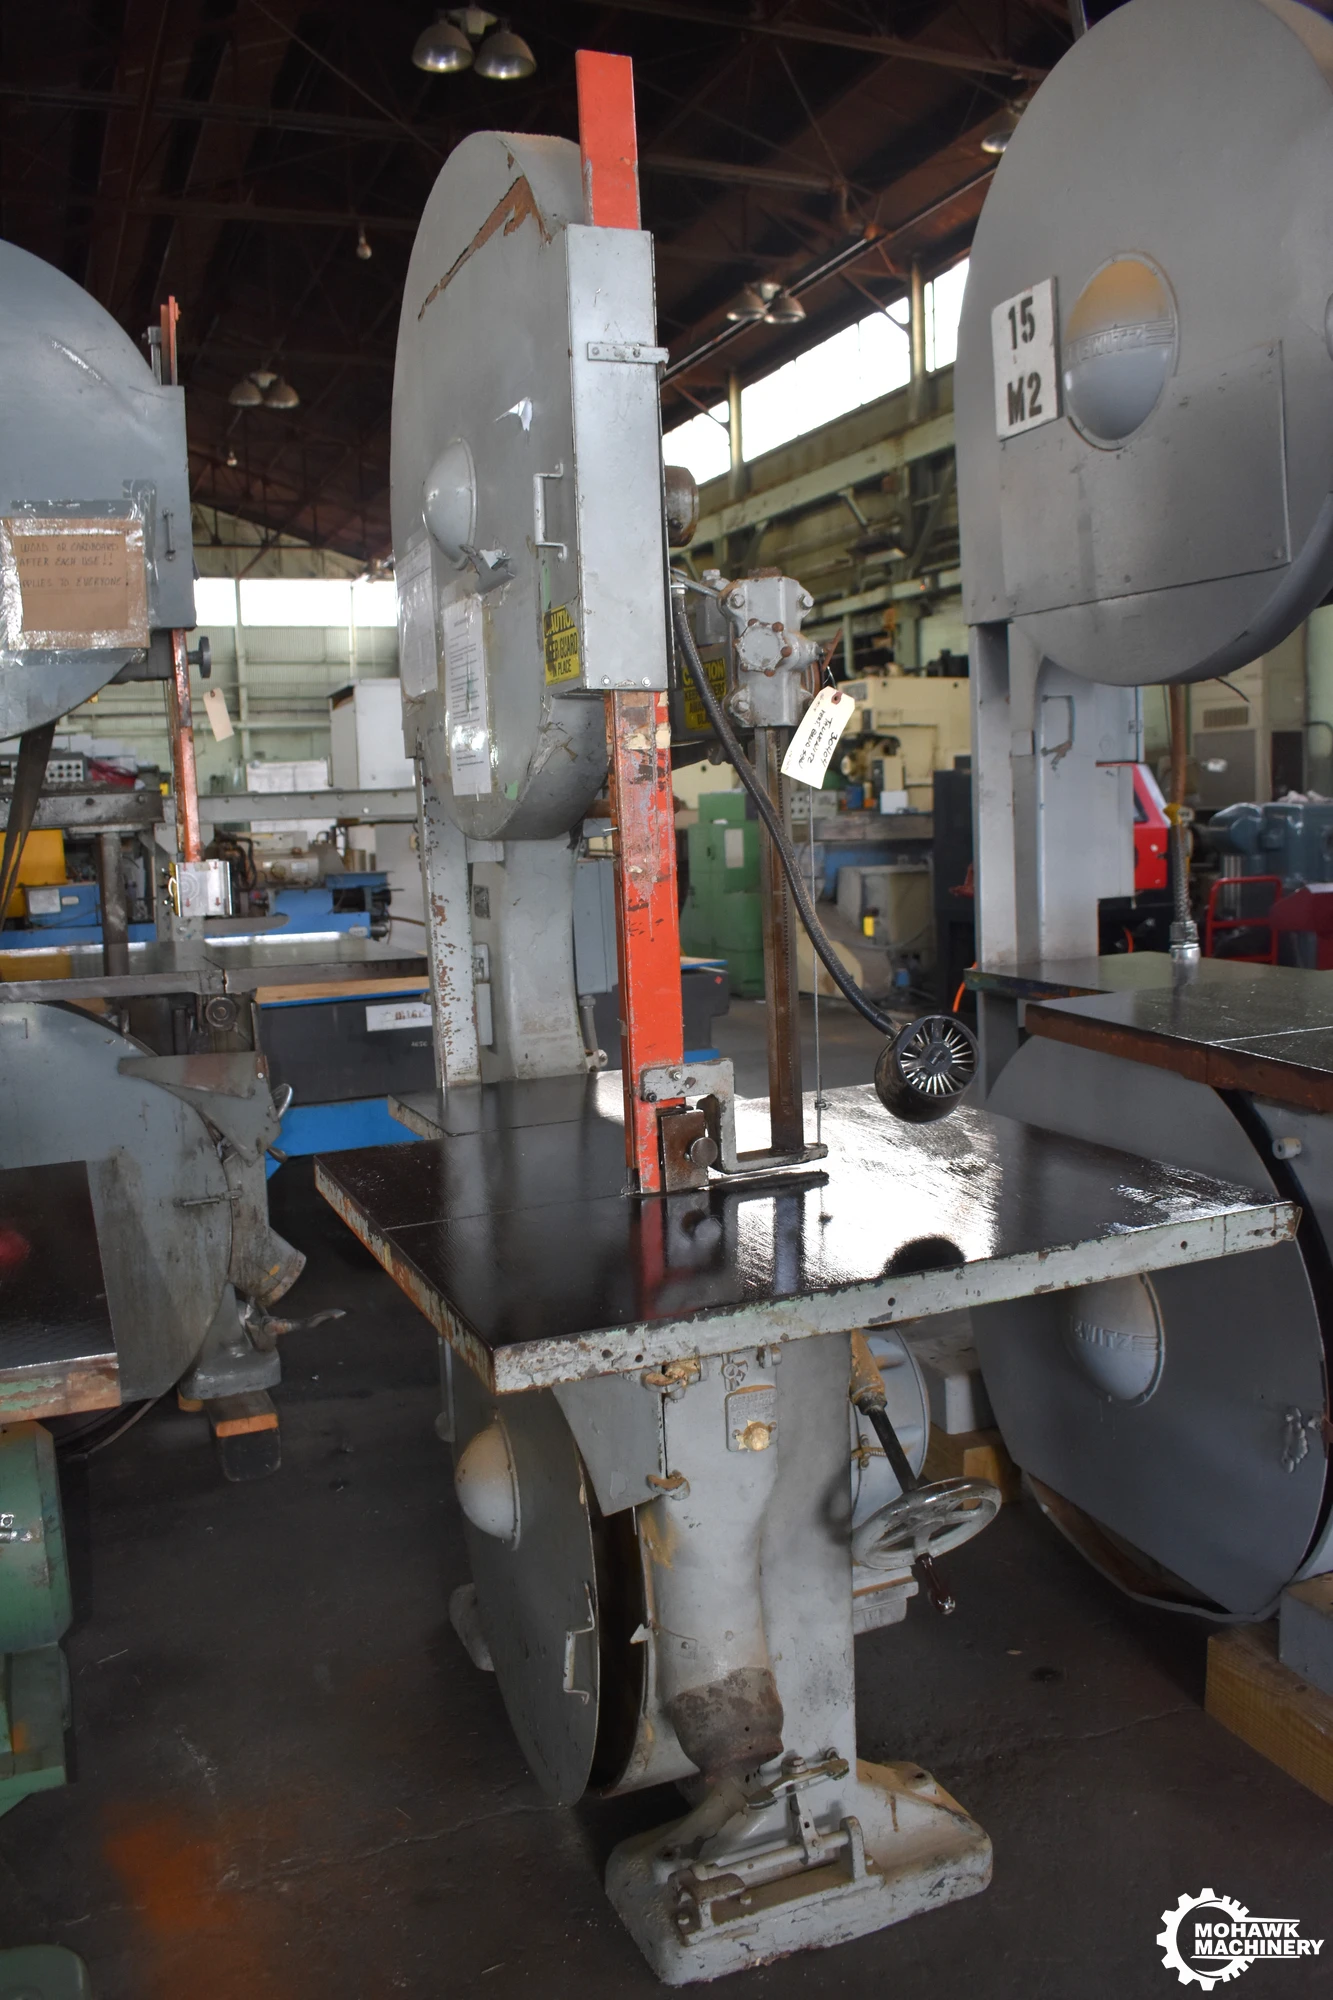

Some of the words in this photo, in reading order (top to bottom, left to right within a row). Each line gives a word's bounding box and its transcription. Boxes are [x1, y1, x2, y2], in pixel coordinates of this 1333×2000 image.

[1008, 296, 1036, 351] 15
[1007, 371, 1043, 426] M2
[20, 556, 49, 567] AFTER
[560, 632, 578, 659] GUARD
[558, 658, 572, 676] PLACE
